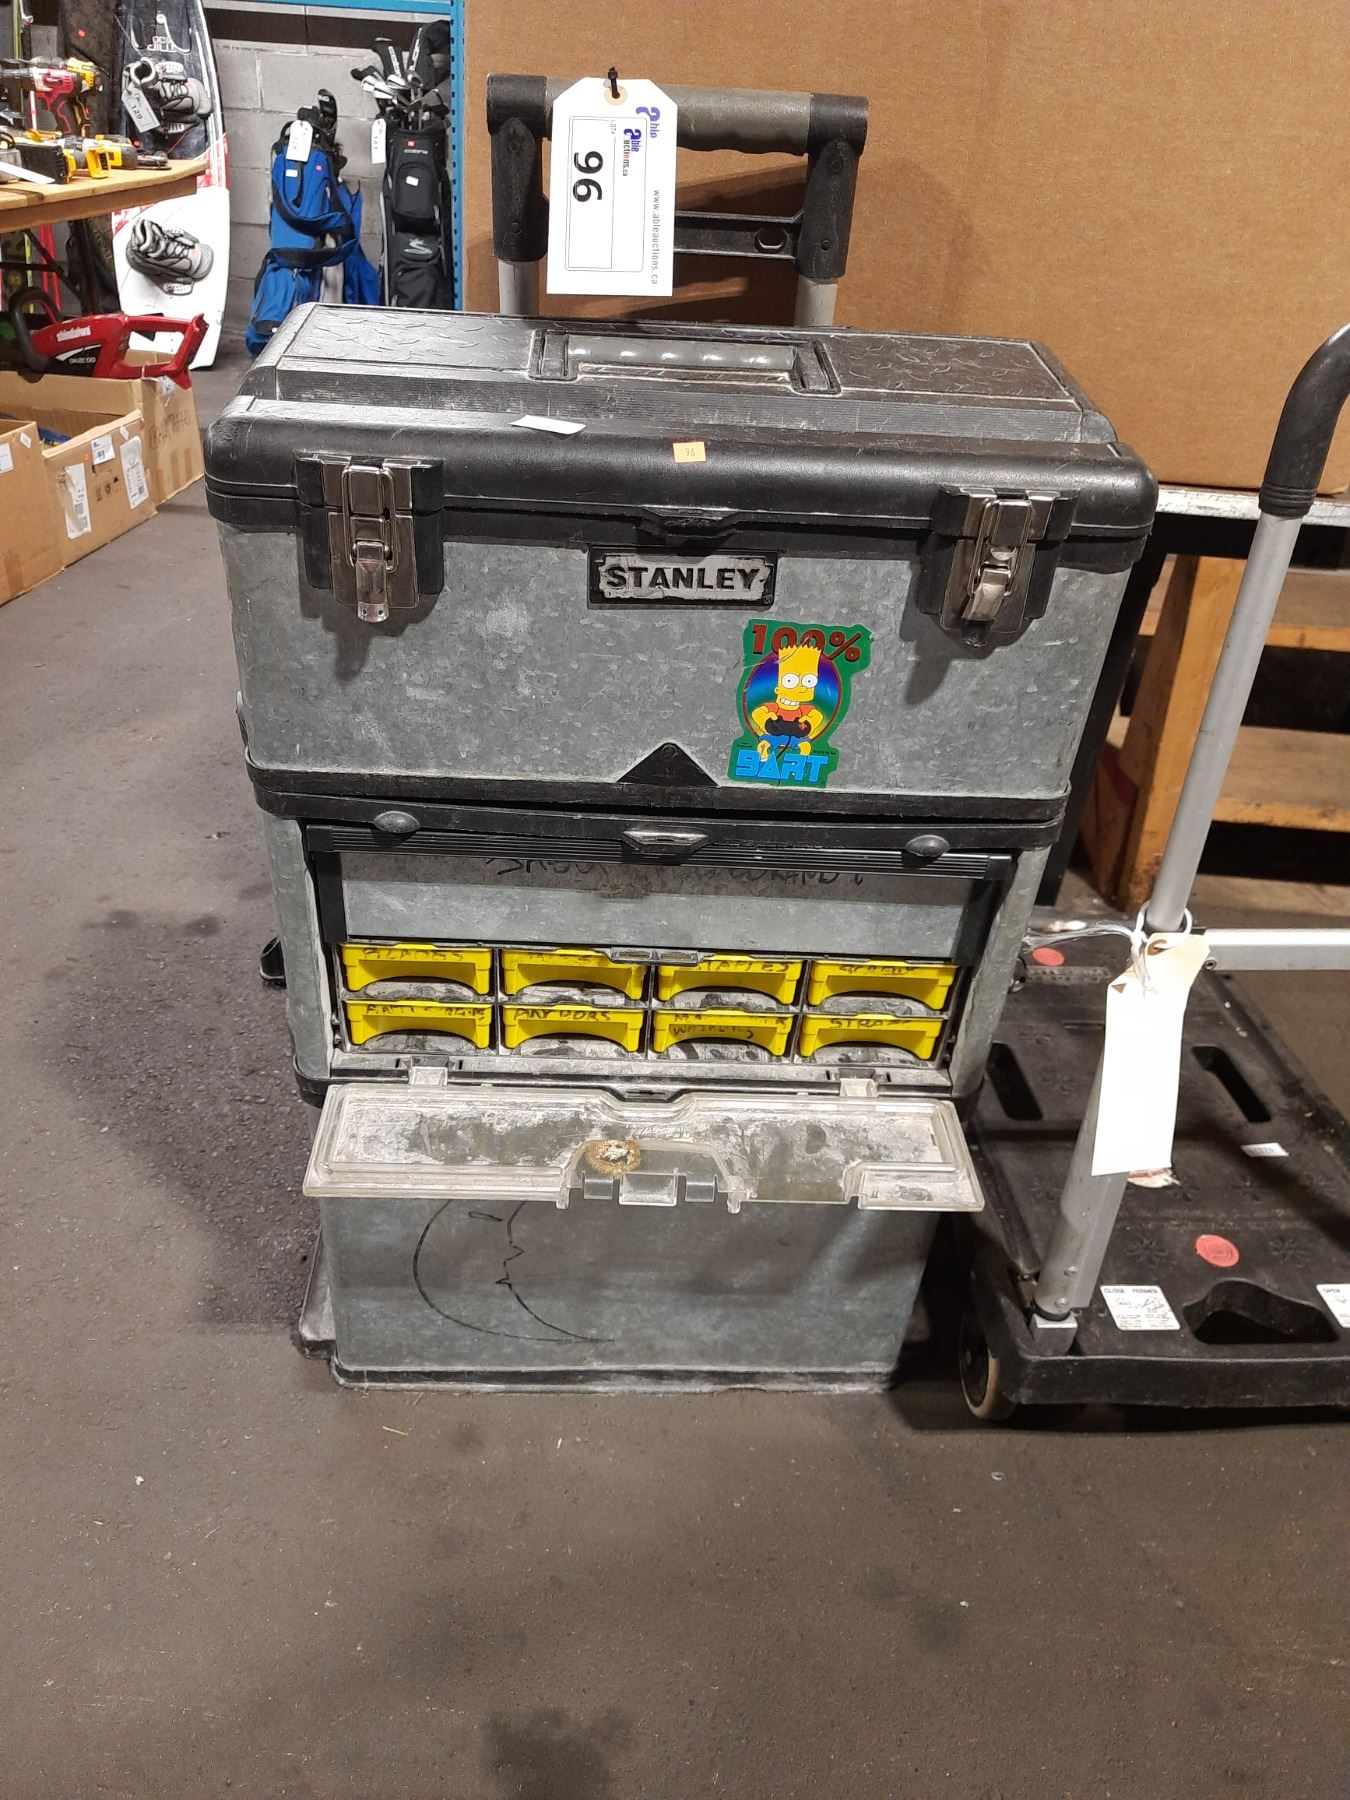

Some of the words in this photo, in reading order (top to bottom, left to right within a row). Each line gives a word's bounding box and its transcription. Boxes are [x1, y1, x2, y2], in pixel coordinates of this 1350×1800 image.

[572, 150, 604, 203] 96
[650, 189, 661, 285] www.ableauctions.ca
[606, 565, 760, 590] STANLEY
[752, 623, 862, 663] 100%
